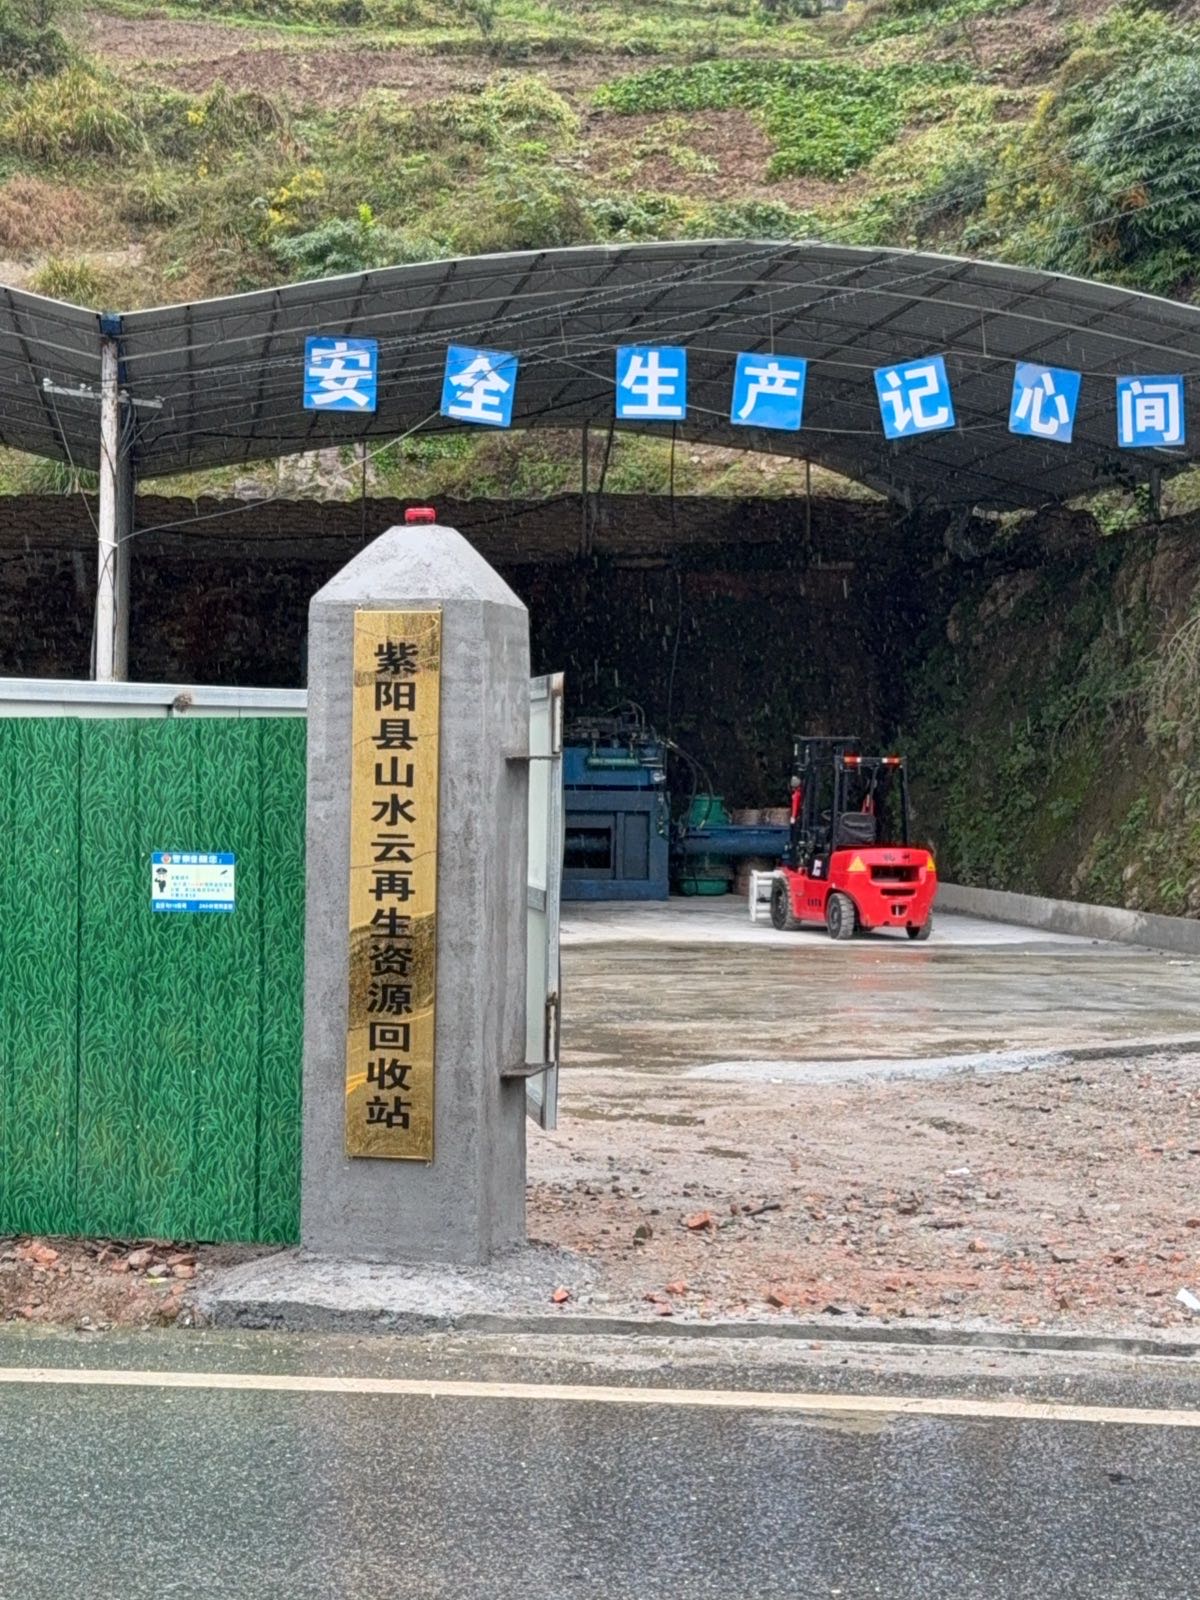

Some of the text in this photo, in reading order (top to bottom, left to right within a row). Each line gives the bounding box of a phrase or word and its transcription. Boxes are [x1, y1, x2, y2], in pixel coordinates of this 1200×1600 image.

[308, 342, 1180, 444] 安全生产记心间
[366, 642, 419, 1130] 紫阳县山水云再生资源回收站
